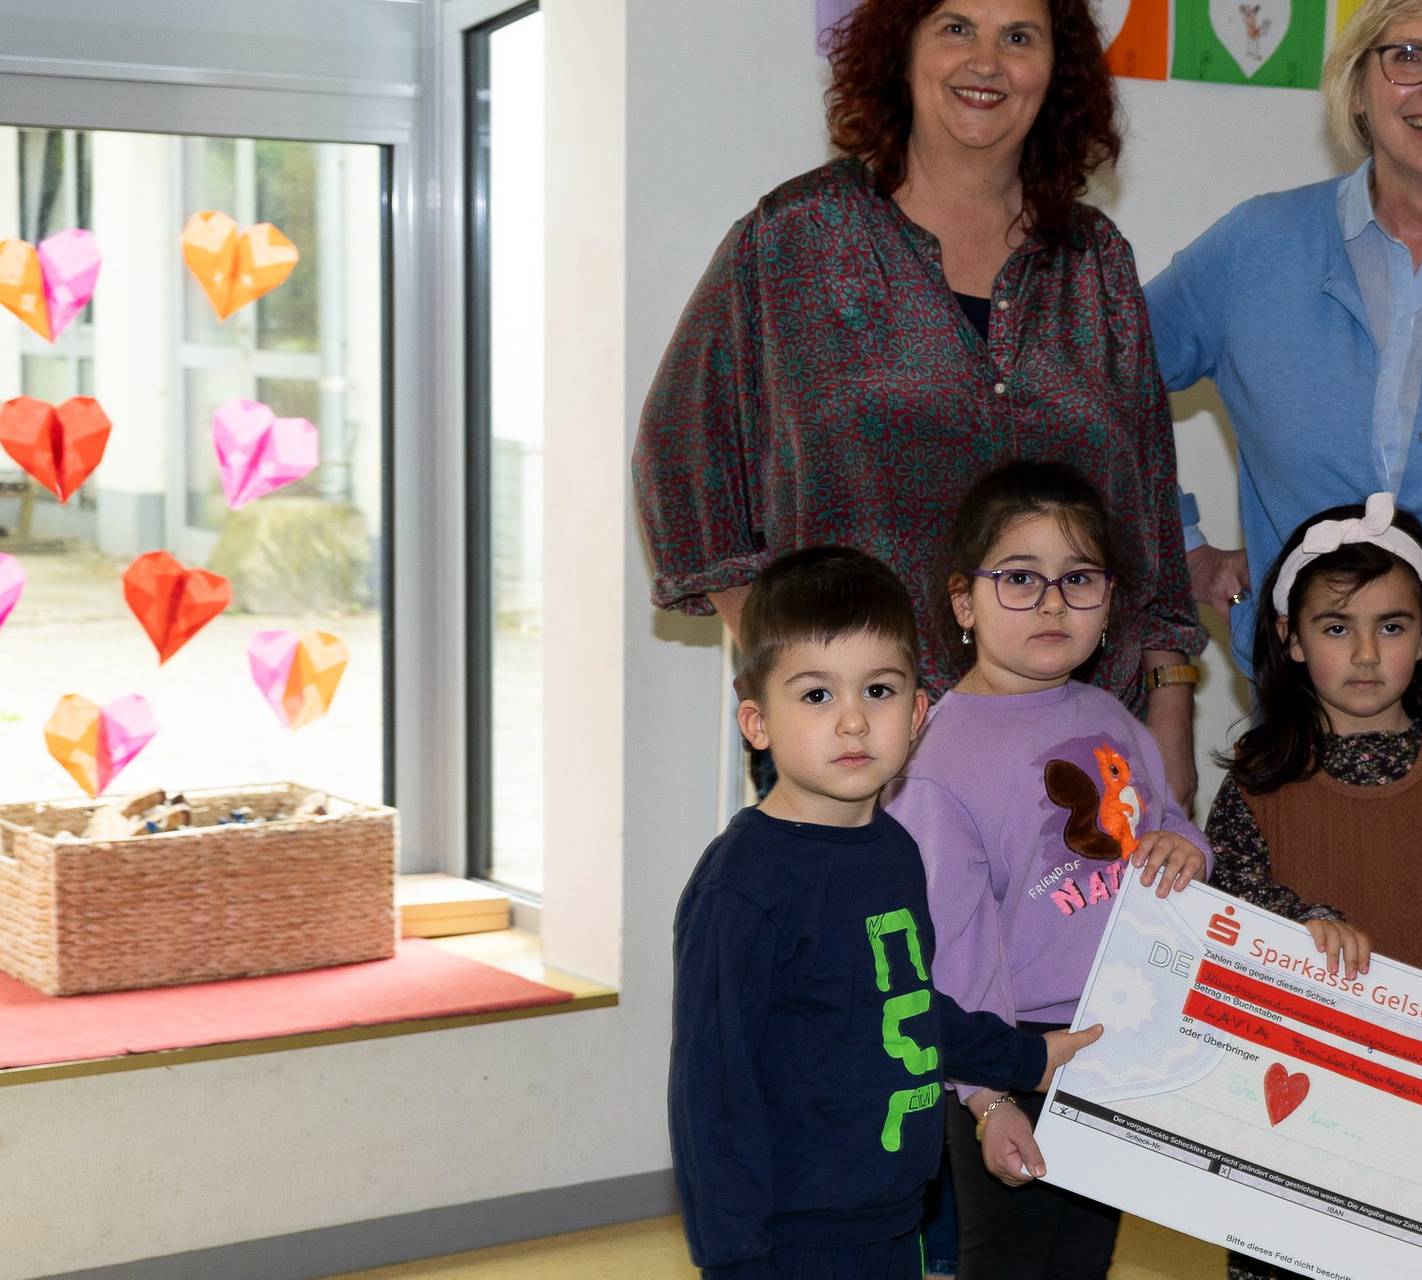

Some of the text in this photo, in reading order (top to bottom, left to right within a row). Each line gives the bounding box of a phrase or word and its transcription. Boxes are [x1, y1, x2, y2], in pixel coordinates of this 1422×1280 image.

[1028, 860, 1081, 899] FRIEND OF
[1050, 862, 1122, 917] NAT
[1148, 940, 1194, 979] DE
[1204, 949, 1337, 1008] Zahlen Sie gegen diesen Scheck
[1249, 938, 1364, 998] Sparkasse
[1182, 1016, 1194, 1026] an
[1193, 981, 1283, 1023] Betrag in Buchstaben
[1203, 1004, 1270, 1041] LAVIA
[1179, 1026, 1260, 1063] oder Überbringer
[1125, 1131, 1161, 1151] Scheck-Nr.
[1113, 1114, 1126, 1125] Der
[1126, 1120, 1169, 1141] vorgedruckte
[1169, 1136, 1207, 1156] Schecktext
[1207, 1149, 1222, 1162] darf
[1221, 1155, 1238, 1168] nicht
[1238, 1161, 1268, 1178] geändert
[1268, 1173, 1285, 1185] oder
[1285, 1180, 1320, 1197] gestrichen
[1320, 1191, 1346, 1206] werden.
[1346, 1201, 1359, 1211] Die
[1359, 1205, 1385, 1220] Angabe
[1385, 1214, 1403, 1226] einer
[1326, 1206, 1346, 1218] IBAN
[1225, 1234, 1246, 1248] Bitte
[1246, 1243, 1274, 1257] dieses
[1274, 1252, 1293, 1265] Feld
[1294, 1259, 1315, 1272] nicht
